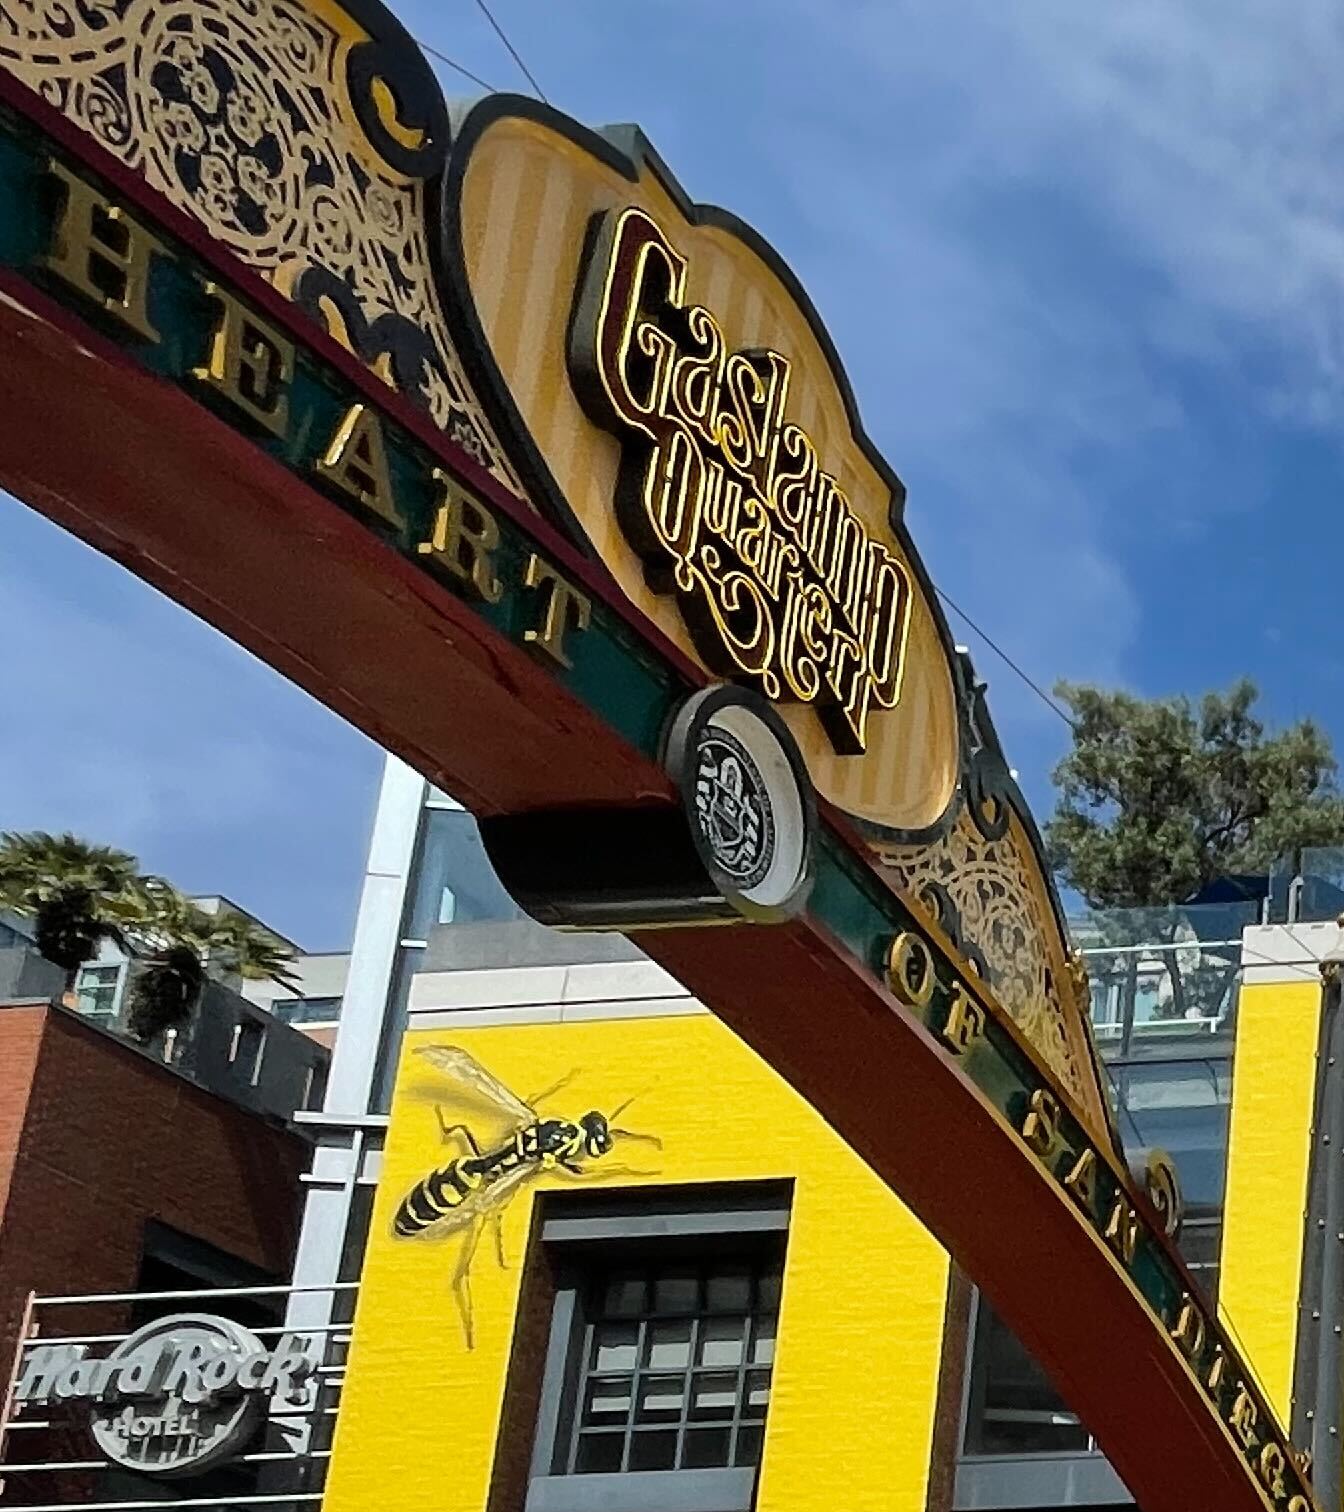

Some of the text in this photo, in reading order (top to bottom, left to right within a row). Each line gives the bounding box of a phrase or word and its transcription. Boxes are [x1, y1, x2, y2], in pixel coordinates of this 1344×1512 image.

[596, 206, 915, 708] Gaslamp
[644, 428, 867, 754] Quarter
[47, 159, 592, 667] HEART
[884, 930, 985, 1055] OF
[1022, 1088, 1142, 1264] SAN
[15, 1332, 316, 1403] Hard Rock
[117, 1414, 198, 1438] HOTEL
